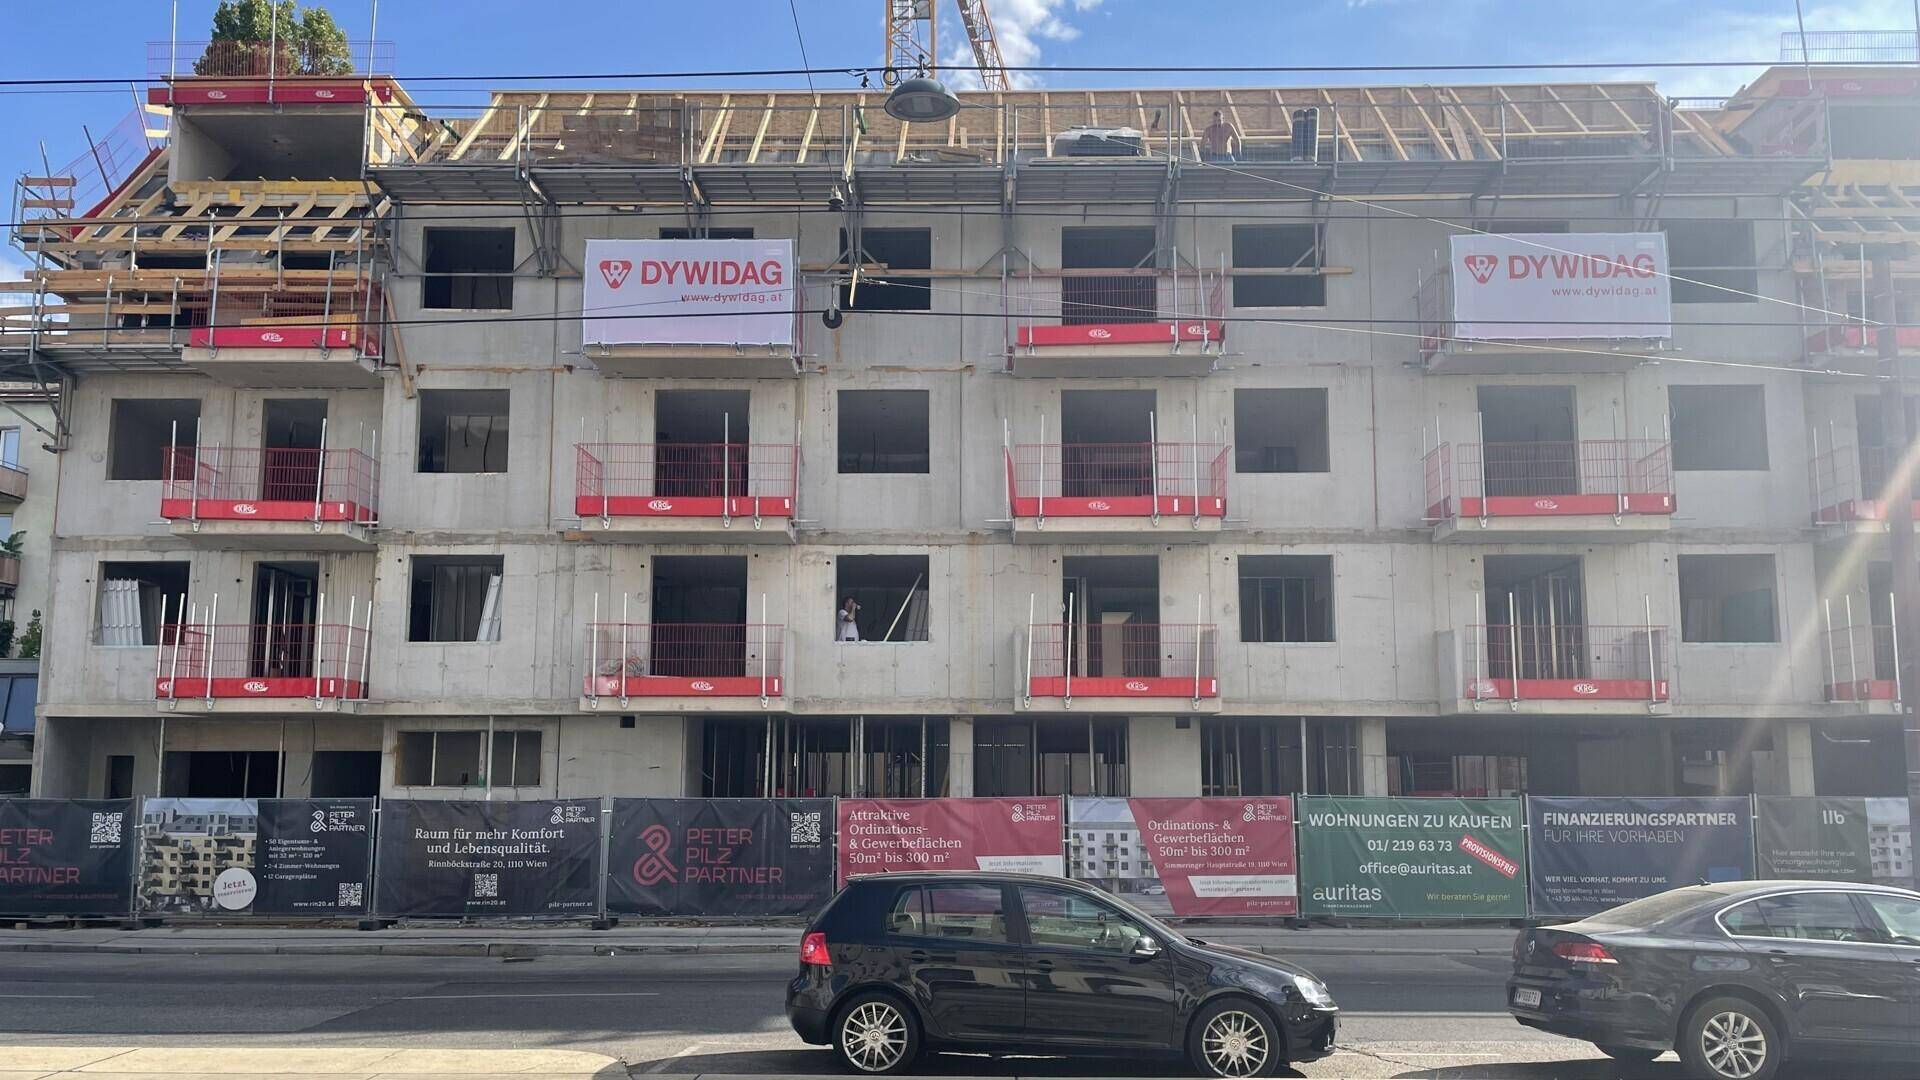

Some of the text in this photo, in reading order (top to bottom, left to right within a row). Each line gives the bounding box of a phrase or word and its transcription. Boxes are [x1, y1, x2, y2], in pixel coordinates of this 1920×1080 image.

[641, 260, 782, 285] DYWIDAG
[1508, 253, 1656, 280] DYWIDAG
[1552, 286, 1657, 298] www.dywidag.at
[682, 293, 782, 304] www.dywidag.at
[849, 810, 910, 821] Attraktive
[1308, 813, 1512, 829] WOHNUNGEN ZU KAUFEN
[1543, 812, 1737, 826] FINANZIERUNGSPARTNER
[849, 824, 928, 835] Ordinations-
[1148, 819, 1232, 831] Ordinations- &
[0, 829, 54, 845] ETER
[415, 828, 564, 839] Raum für mehr Komfort
[687, 828, 753, 845] PETER
[1153, 833, 1244, 844] Gewerbeflächen
[1576, 830, 1604, 843] IHRE
[1609, 830, 1684, 843] VORHABEN
[849, 837, 962, 849] & Gewerbeflächen
[1367, 839, 1453, 852] 01/ 219 63 73
[427, 842, 550, 857] und Lebensqualität.
[1159, 846, 1250, 857] 50m² bis 300 m²
[686, 848, 732, 864] PILZ
[849, 852, 950, 863] 50m² bis 300 m²
[1462, 837, 1516, 875] PROVISIONSFREI
[428, 860, 491, 868] Rinnböckstraße
[493, 861, 505, 869] 20,
[526, 860, 548, 868] Wien
[1164, 862, 1205, 870] Simmeringer
[1206, 862, 1246, 870] Hauptstraße
[1359, 861, 1472, 876] office@auritas.at
[0, 867, 80, 884] ARTNER
[685, 867, 784, 884] PARTNER
[1580, 876, 1610, 884] VORHAT,
[223, 879, 247, 890] Jetzt
[1312, 883, 1382, 901] auritas
[1426, 892, 1511, 903] Wir beraten Sie gerne!
